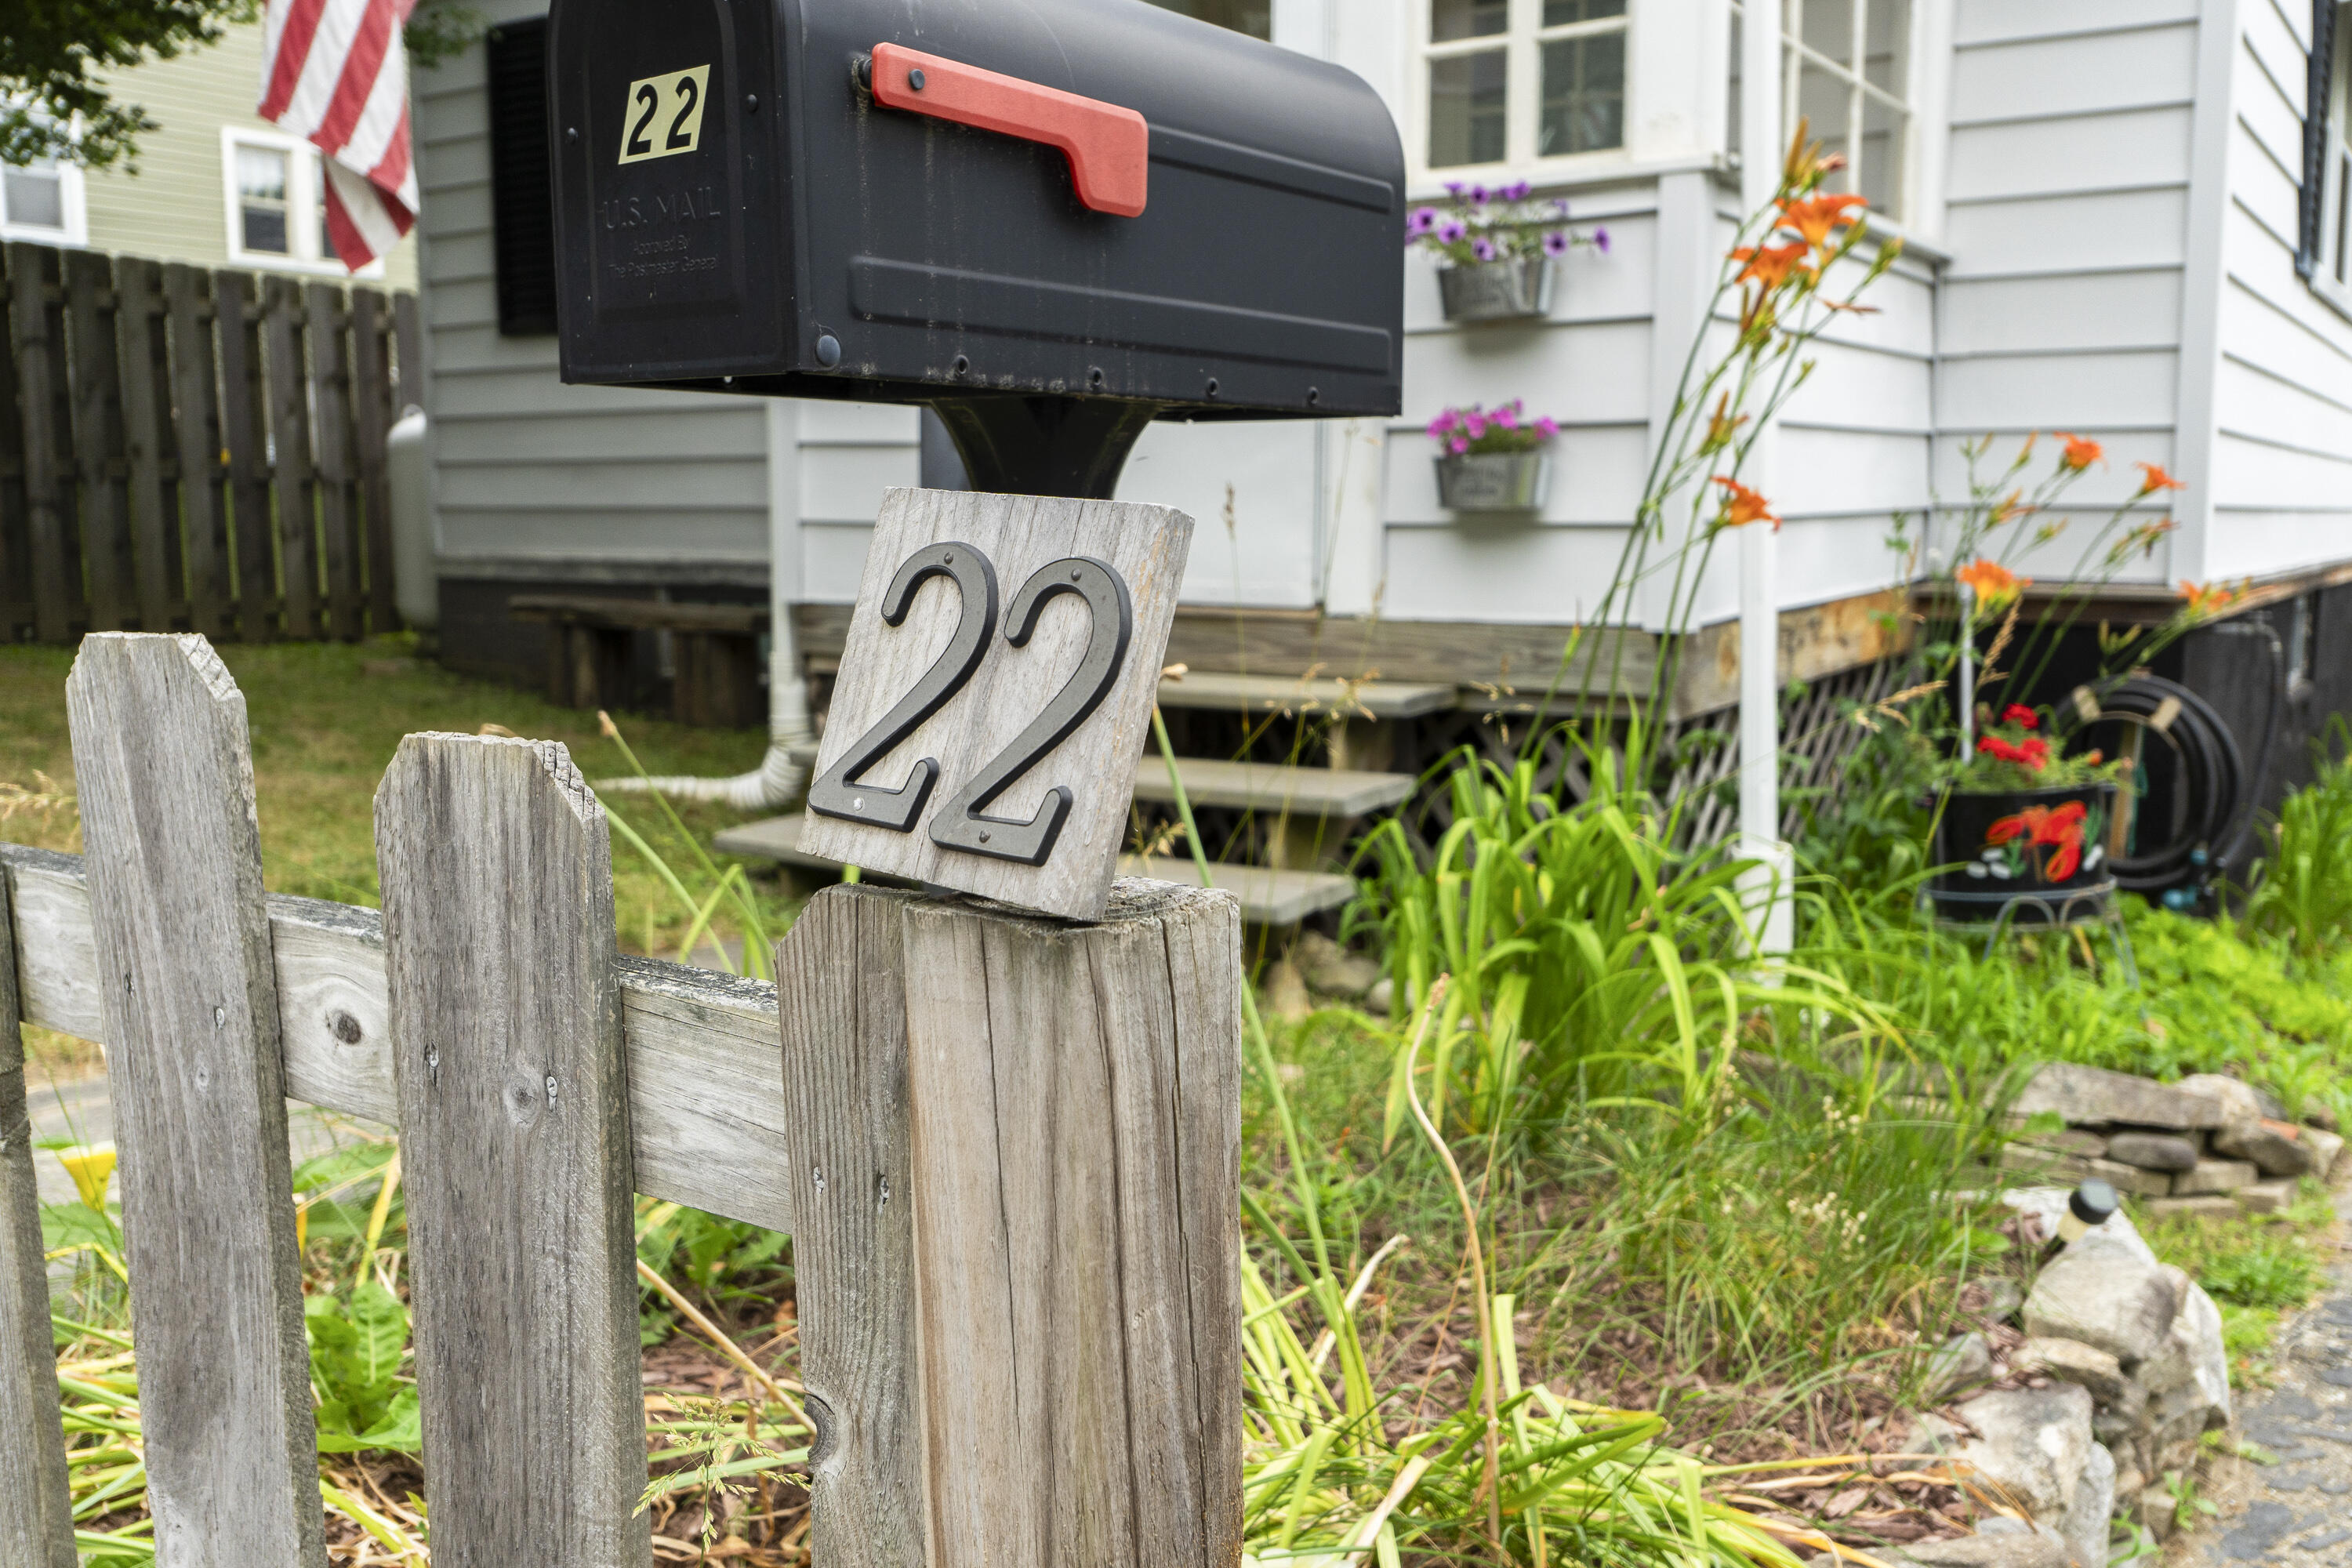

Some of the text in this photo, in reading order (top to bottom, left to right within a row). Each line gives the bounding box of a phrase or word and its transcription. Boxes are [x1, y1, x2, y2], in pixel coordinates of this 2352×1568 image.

[626, 76, 699, 157] 22
[603, 186, 721, 230] U.S. MAIL
[807, 540, 1133, 868] 22
